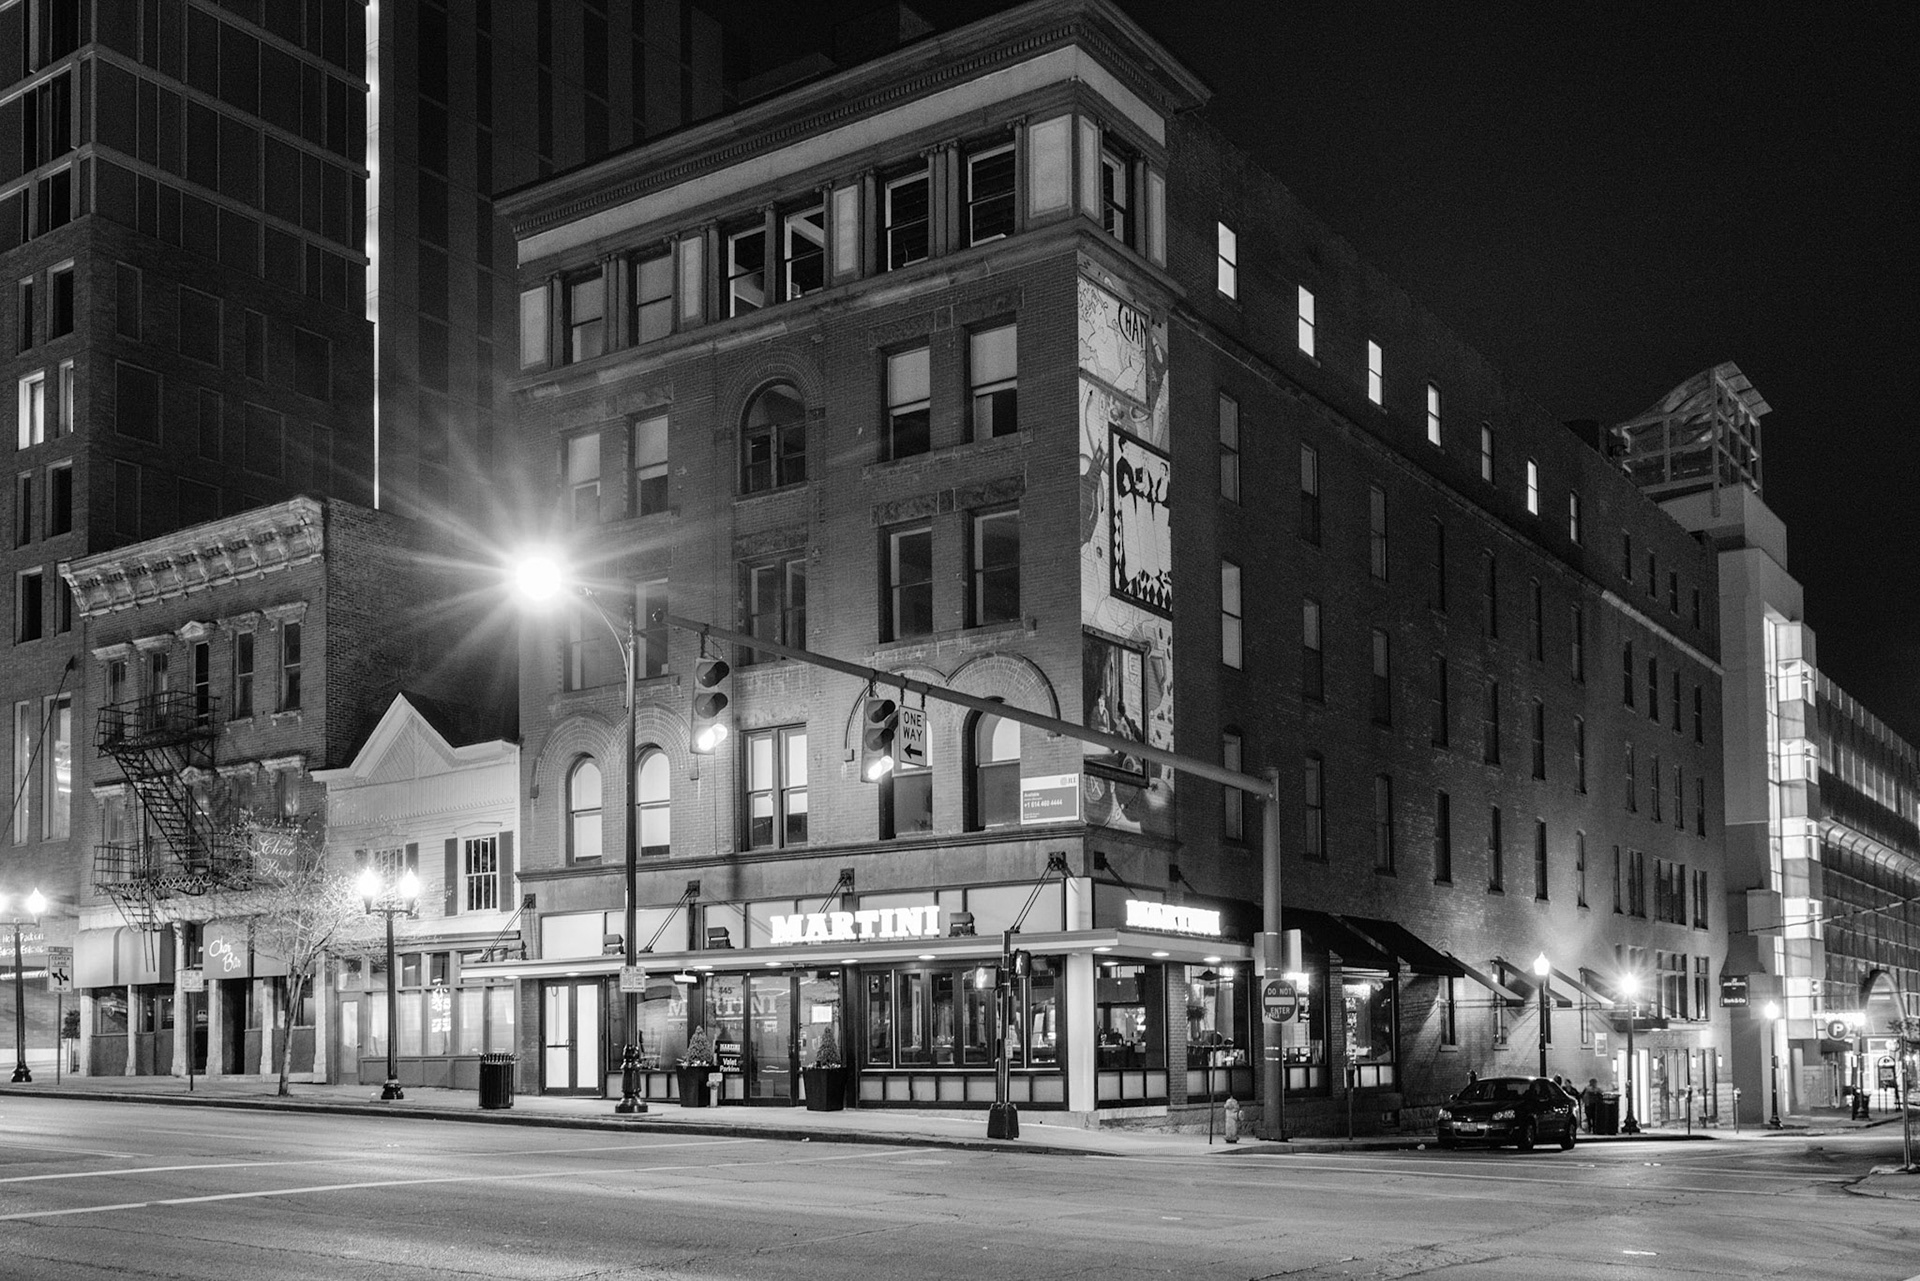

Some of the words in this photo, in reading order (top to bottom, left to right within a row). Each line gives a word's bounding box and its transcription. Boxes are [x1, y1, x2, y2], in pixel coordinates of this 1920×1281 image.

[904, 711, 922, 727] ONE
[903, 725, 923, 742] WAY
[1050, 798, 1063, 806] 4444
[259, 836, 298, 857] Char
[259, 858, 294, 878] Bar
[769, 905, 940, 944] MARTINI
[209, 935, 232, 957] Char
[222, 952, 241, 972] Bar
[1268, 987, 1277, 996] DO
[1279, 987, 1292, 996] NOT
[1270, 1006, 1291, 1015] ENTER
[1833, 1023, 1844, 1036] P
[722, 1057, 738, 1066] Valet
